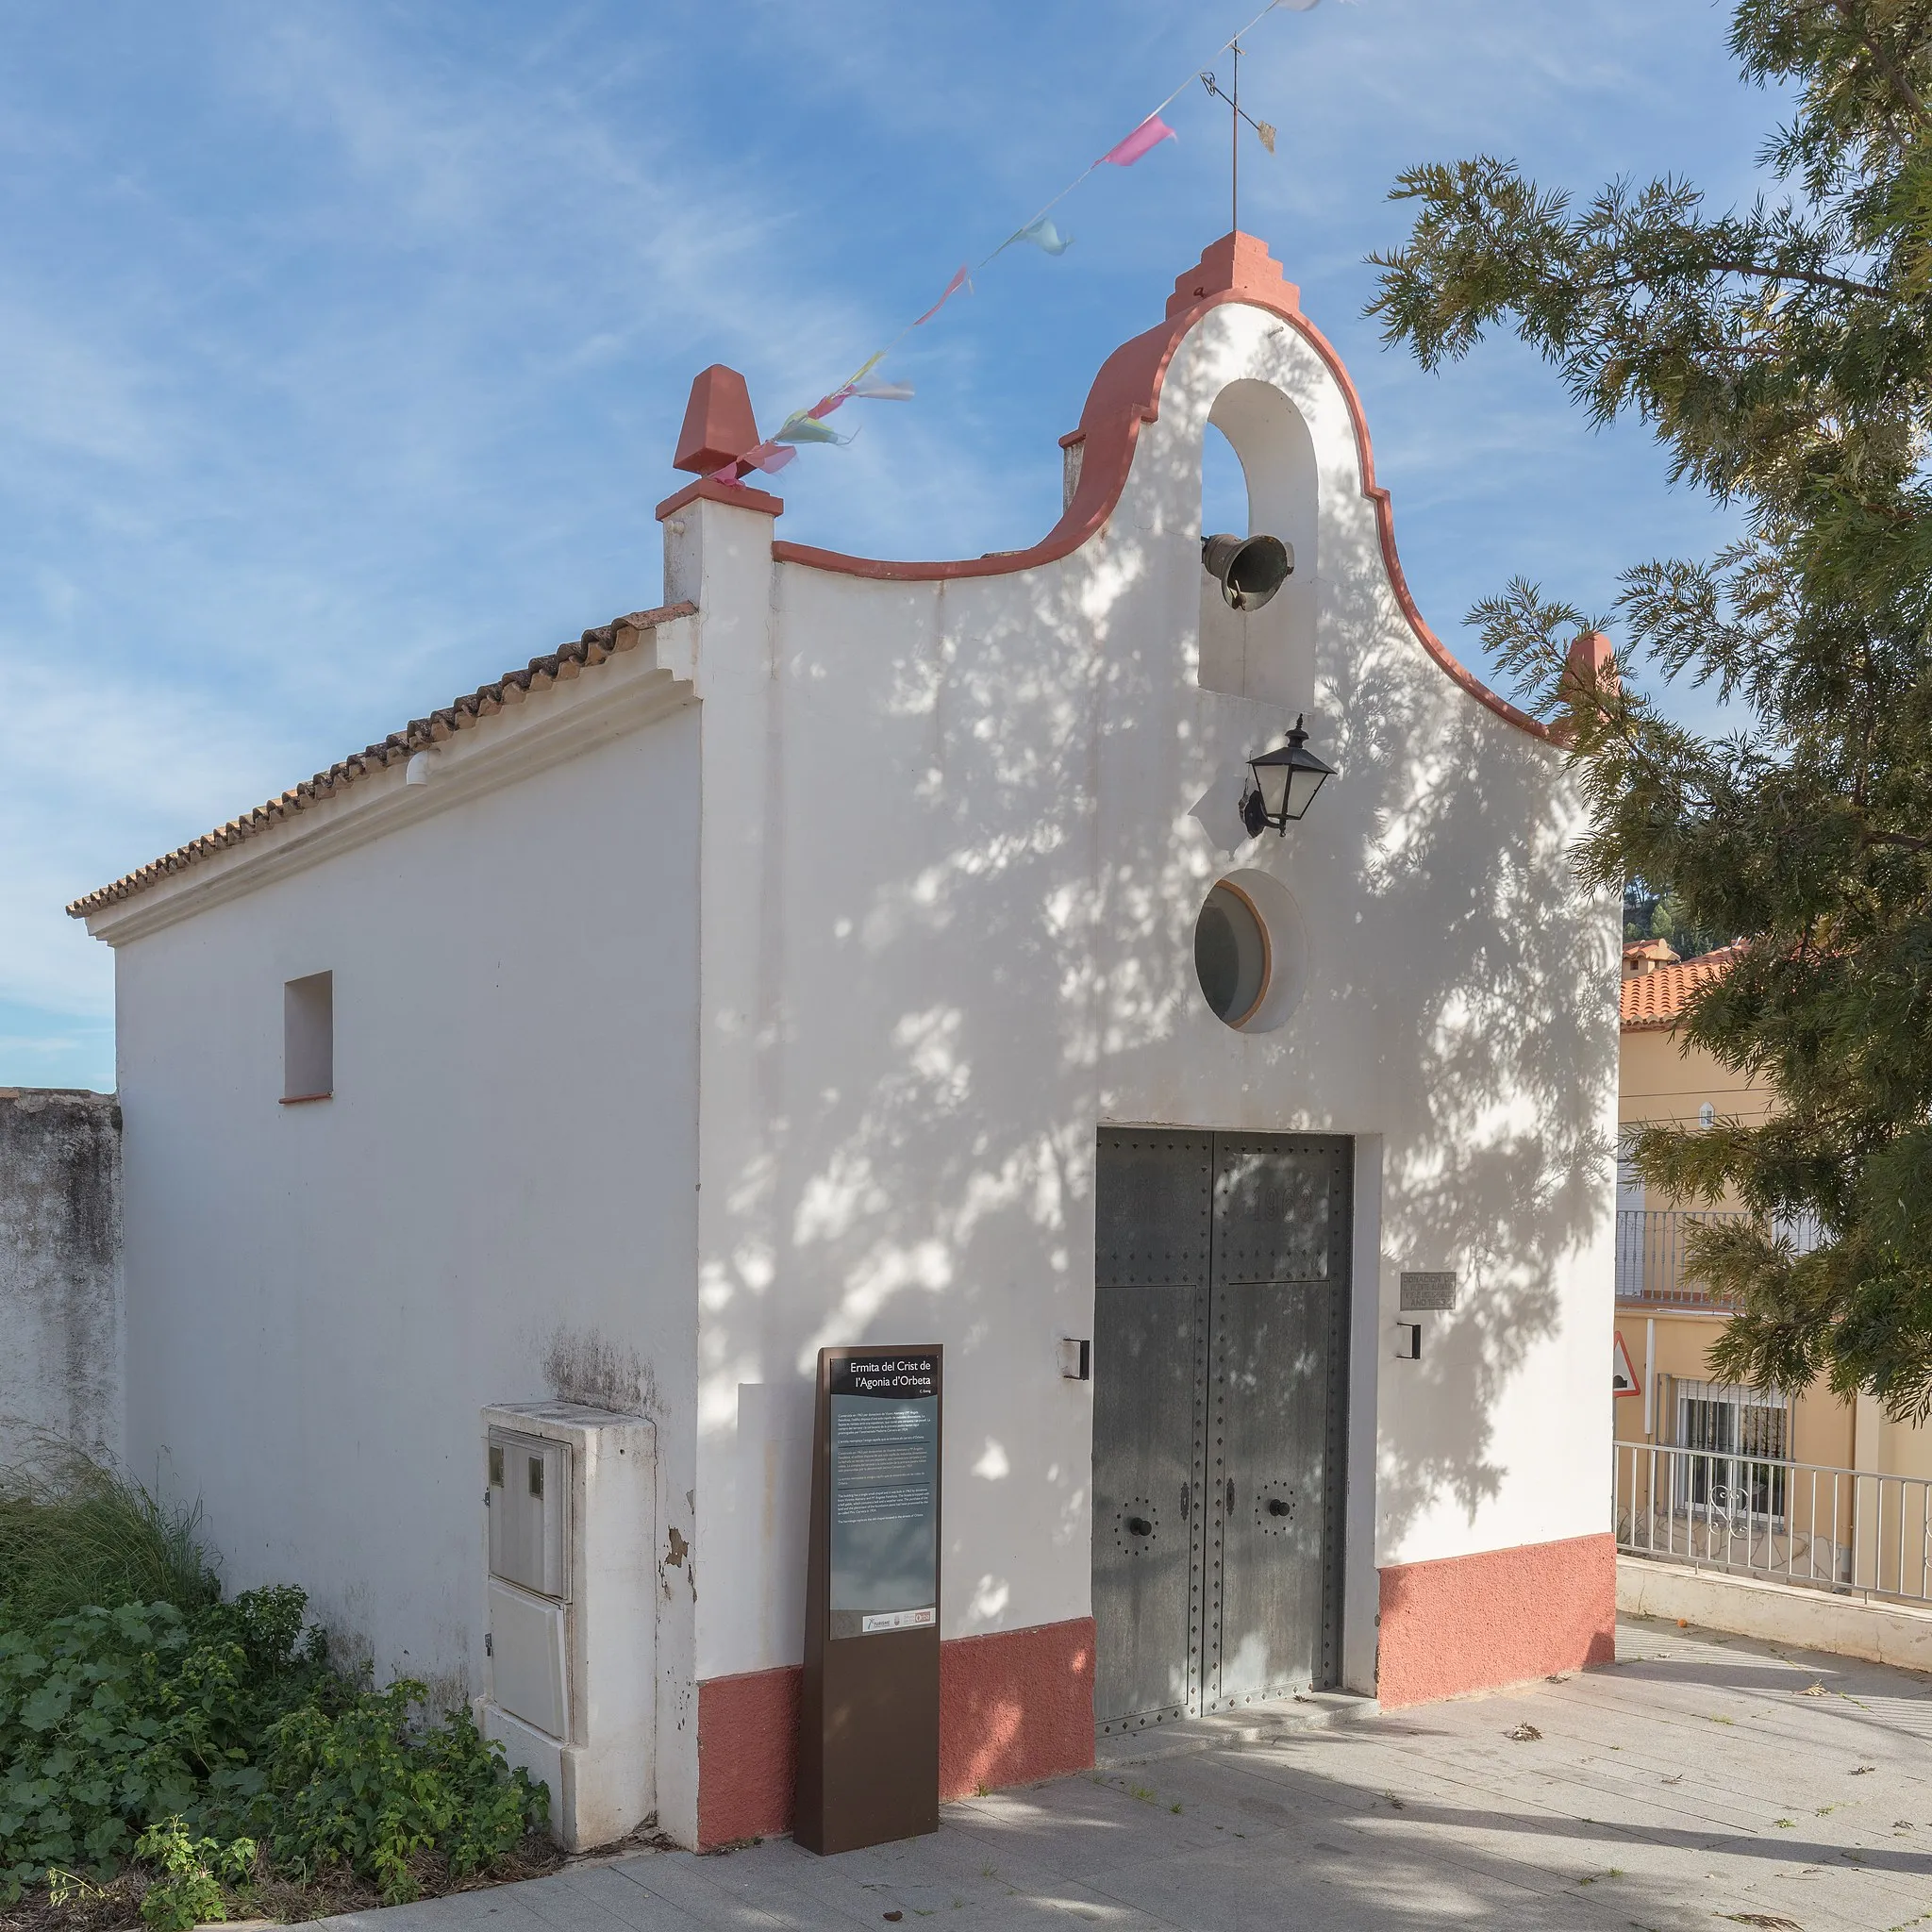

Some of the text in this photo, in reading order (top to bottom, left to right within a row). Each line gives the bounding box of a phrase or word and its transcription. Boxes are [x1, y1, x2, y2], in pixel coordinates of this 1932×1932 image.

[850, 1360, 931, 1373] Ermita del Crist de
[856, 1375, 931, 1390] l'Agonia d'Orbeta
[915, 1613, 930, 1622] Orba
